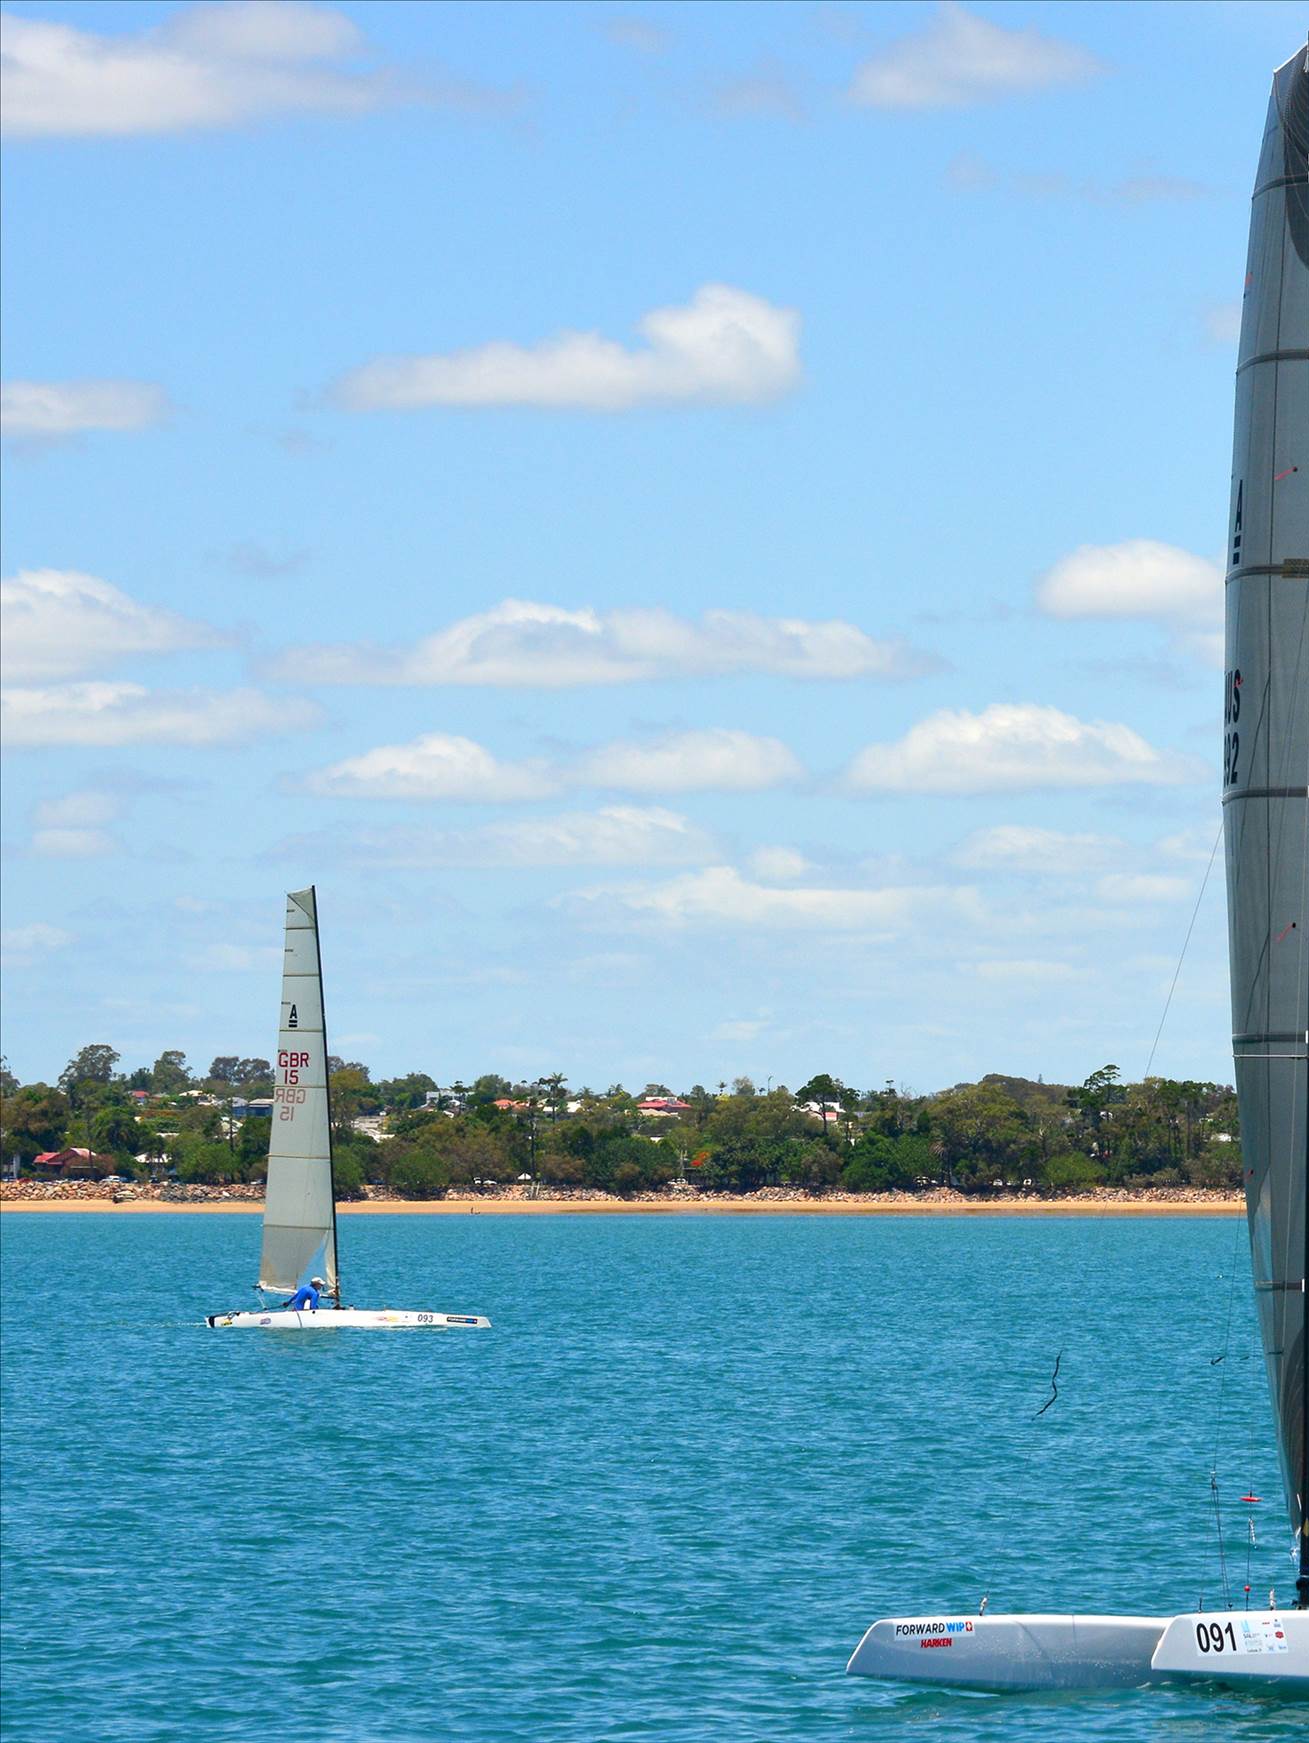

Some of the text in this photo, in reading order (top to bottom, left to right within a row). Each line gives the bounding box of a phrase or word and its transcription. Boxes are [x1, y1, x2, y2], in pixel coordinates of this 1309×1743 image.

[289, 1004, 298, 1019] A
[278, 1052, 309, 1068] GBR
[284, 1069, 299, 1085] 15
[417, 1313, 434, 1323] 093
[895, 1621, 965, 1636] FORWARD WIP
[920, 1637, 953, 1649] HARKEN
[1196, 1621, 1237, 1653] 091
